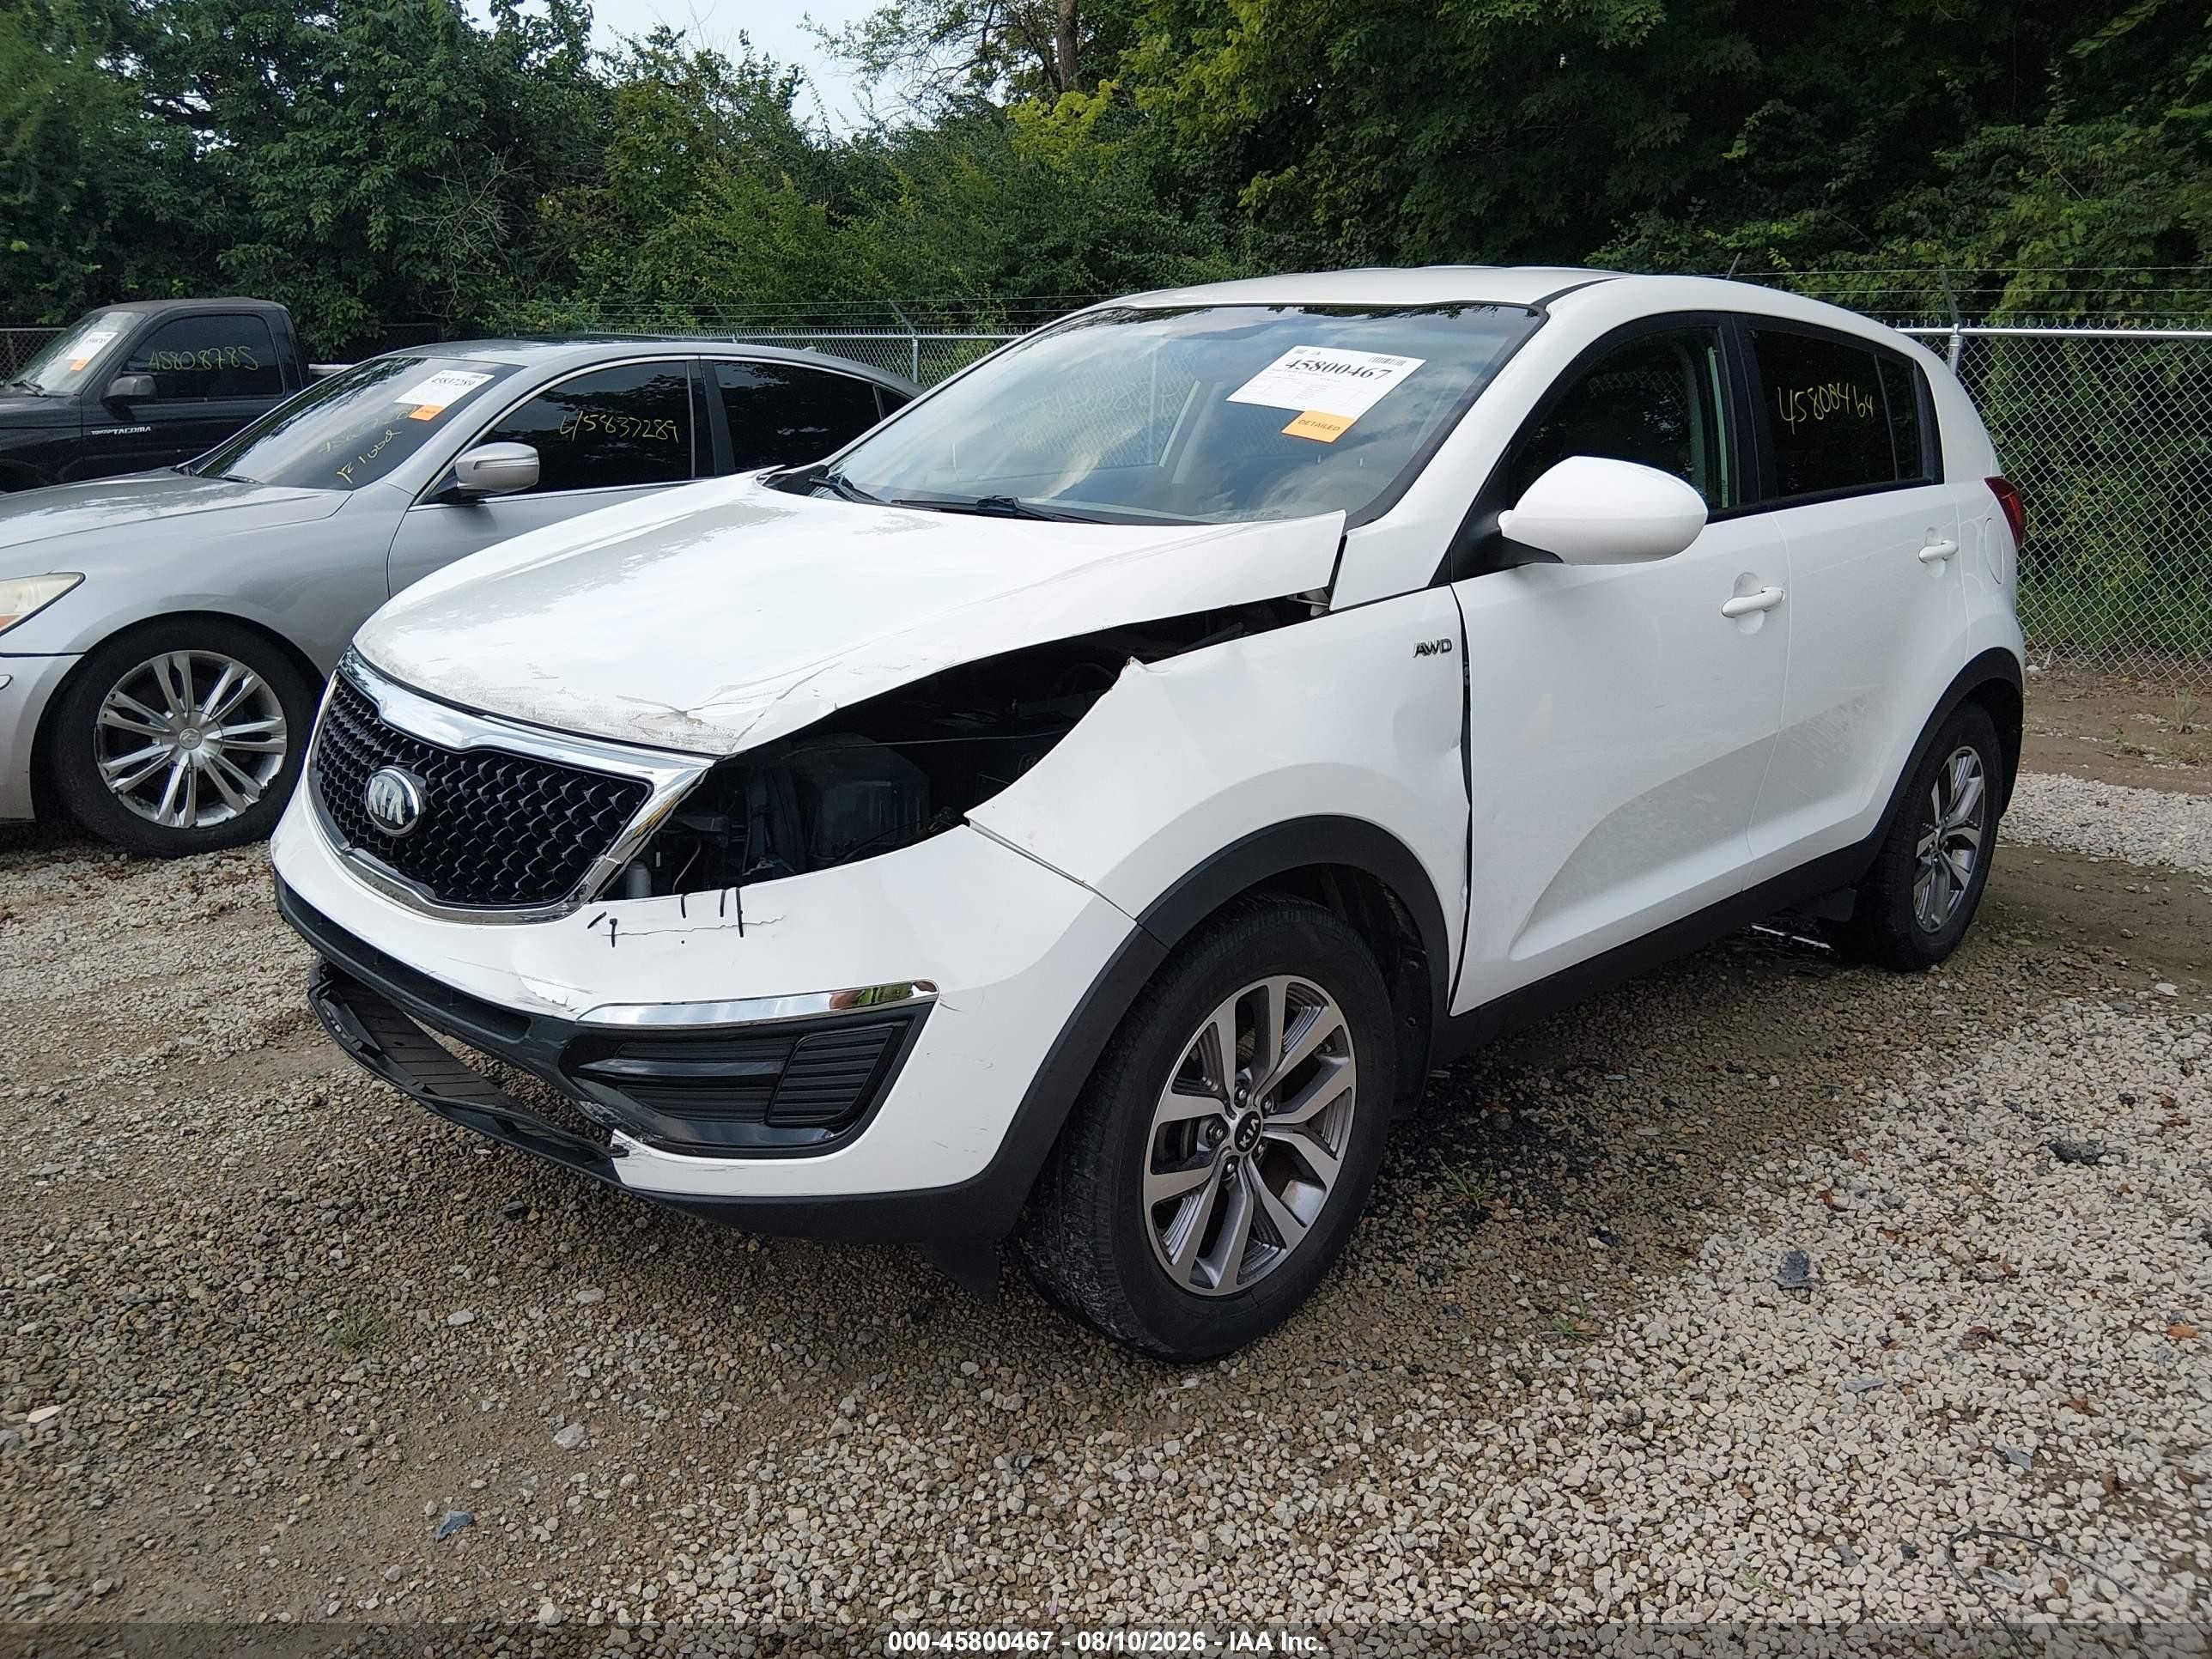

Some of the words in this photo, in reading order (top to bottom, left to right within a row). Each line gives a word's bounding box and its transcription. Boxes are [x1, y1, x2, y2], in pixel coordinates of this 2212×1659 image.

[1285, 358, 1392, 380] 45800467
[113, 426, 151, 434] TACOMA
[1297, 419, 1340, 432] DETAILED
[1413, 638, 1452, 659] AWD
[1239, 1119, 1260, 1148] KIA
